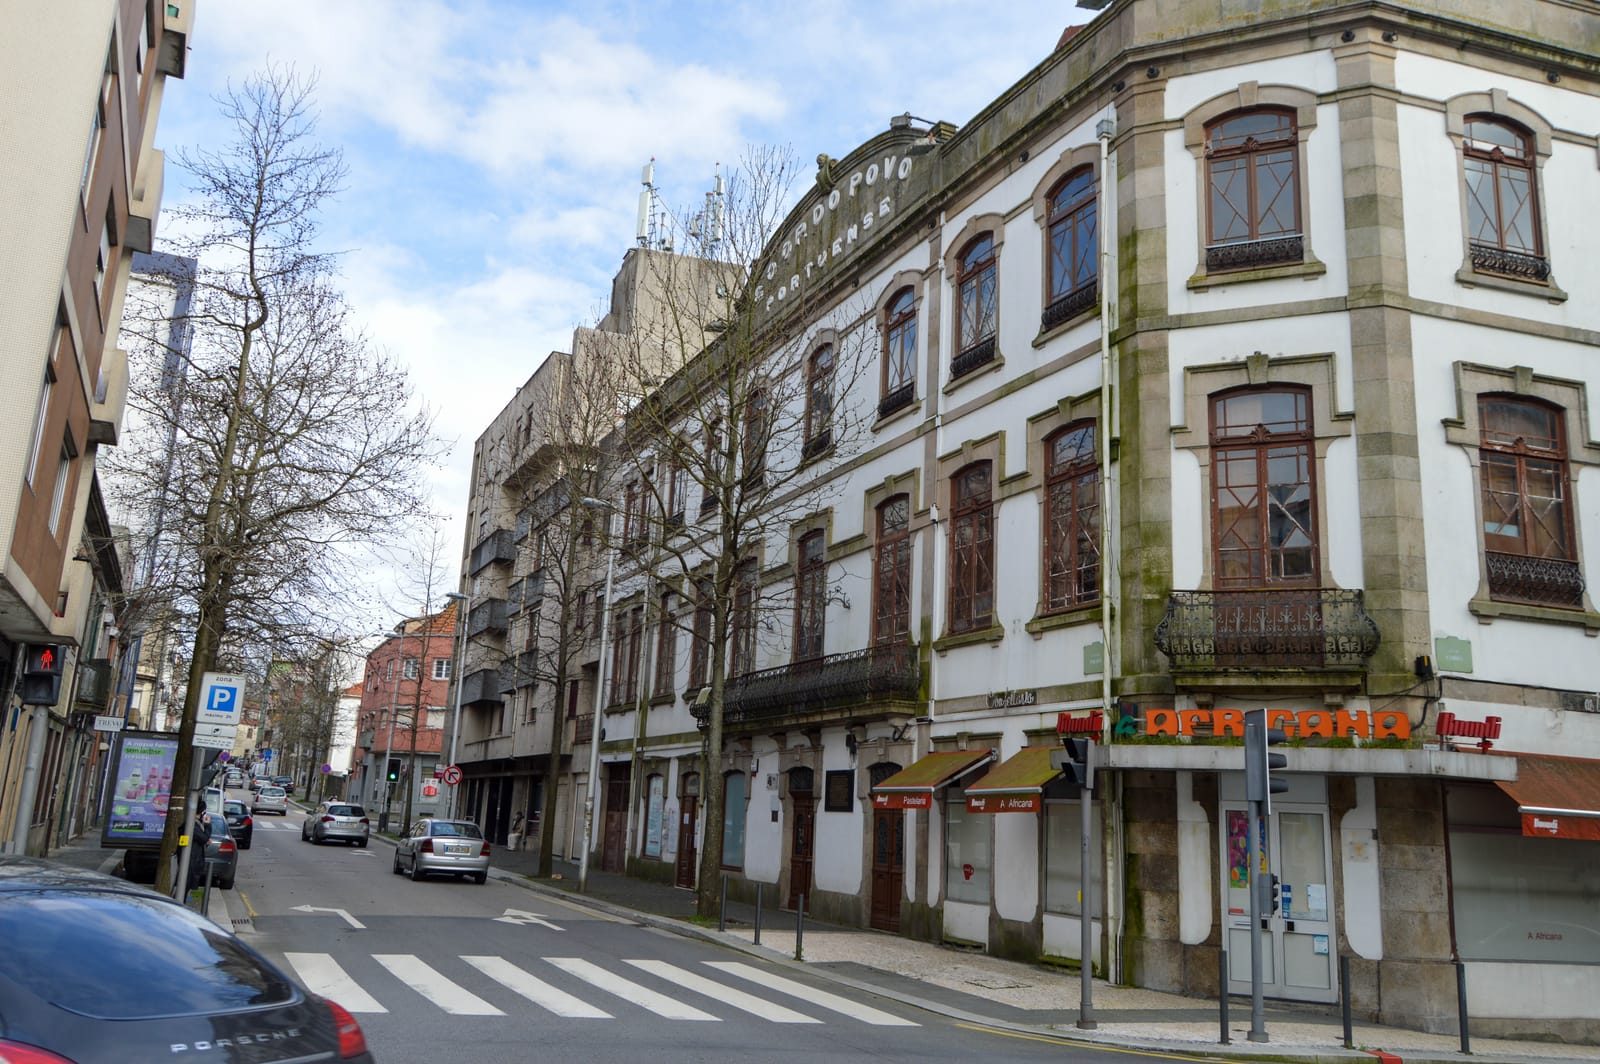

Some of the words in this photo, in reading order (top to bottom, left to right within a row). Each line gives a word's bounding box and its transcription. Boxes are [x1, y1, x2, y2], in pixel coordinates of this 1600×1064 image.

[813, 190, 840, 225] DO
[849, 155, 912, 197] POVO
[765, 196, 890, 311] PORTUENSE
[212, 688, 231, 709] P
[1145, 709, 1411, 739] AFRCANA
[170, 1028, 301, 1053] PORSCHE
